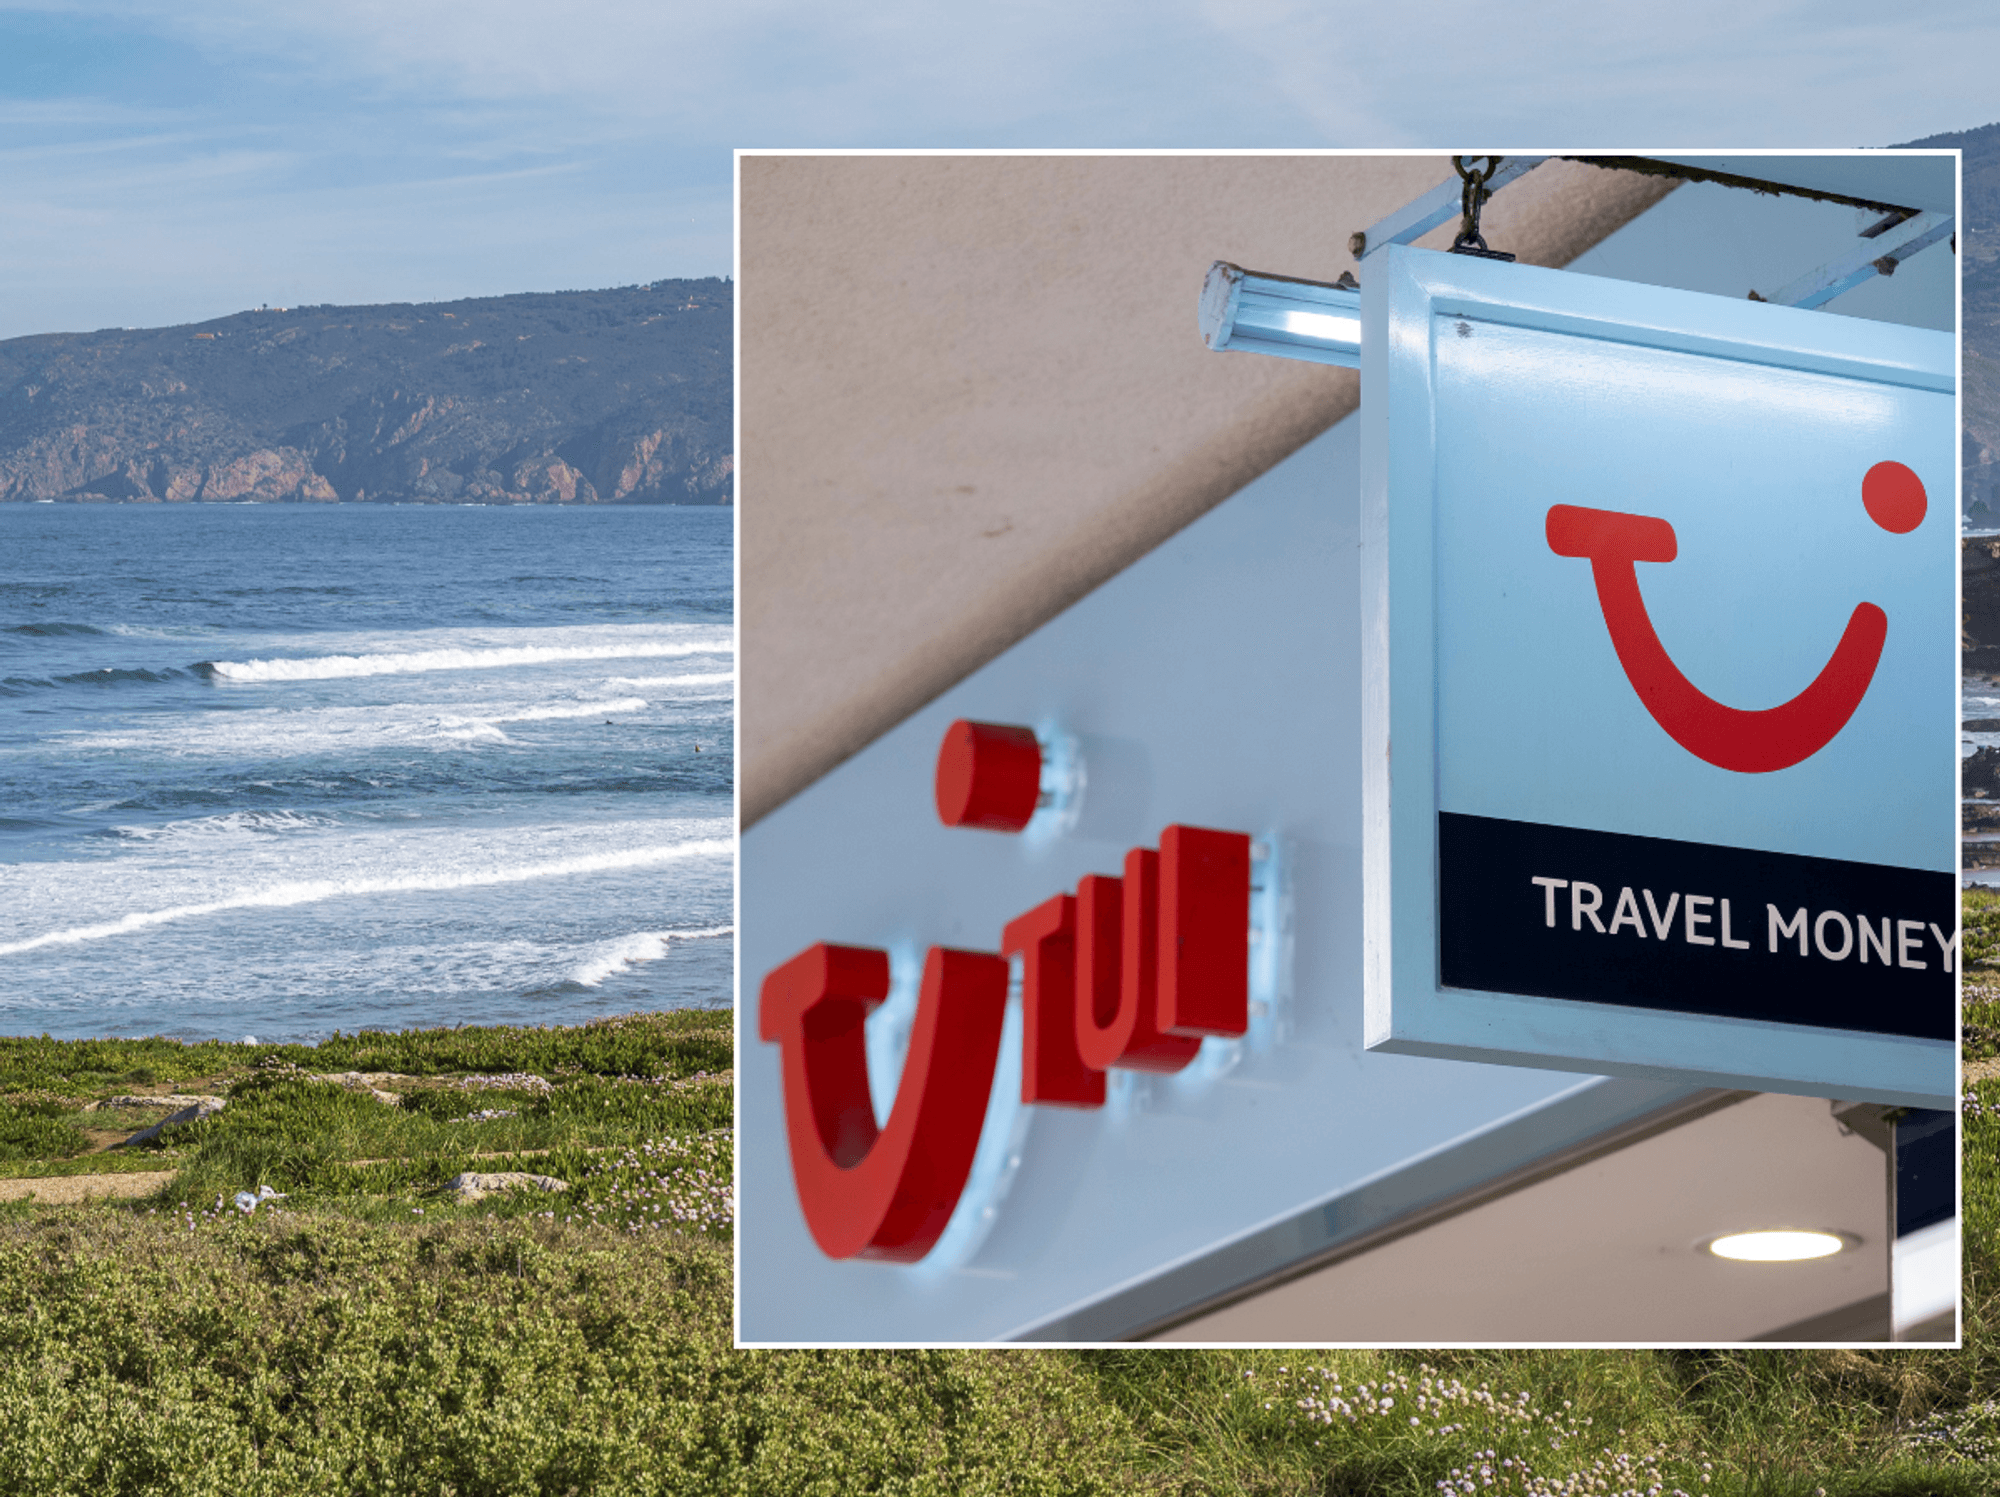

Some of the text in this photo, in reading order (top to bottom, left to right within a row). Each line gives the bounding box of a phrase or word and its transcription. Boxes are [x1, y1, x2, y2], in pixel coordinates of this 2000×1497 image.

[1002, 824, 1251, 1109] TUI
[1532, 876, 1956, 973] TRAVEL MONEY
